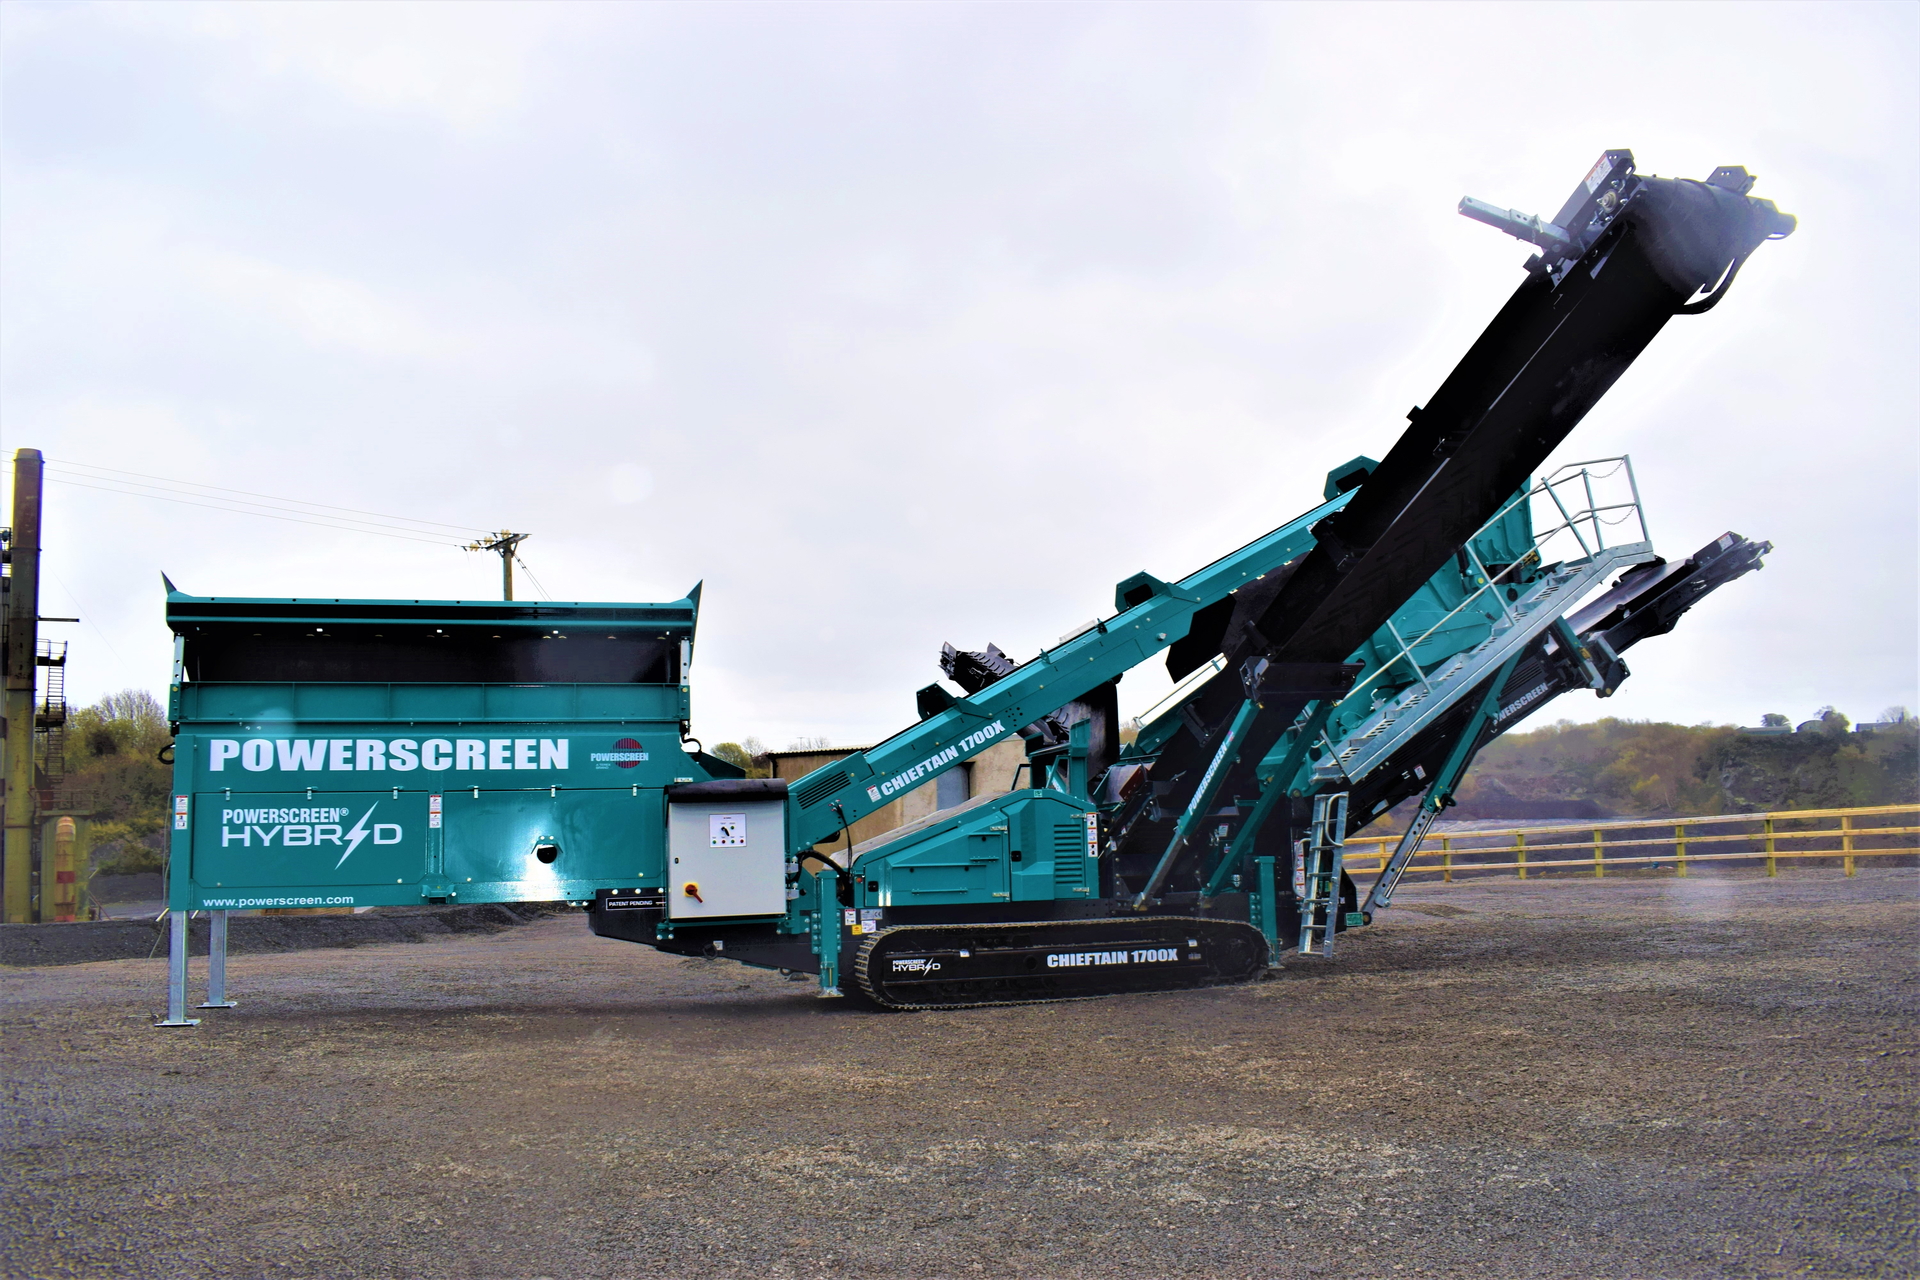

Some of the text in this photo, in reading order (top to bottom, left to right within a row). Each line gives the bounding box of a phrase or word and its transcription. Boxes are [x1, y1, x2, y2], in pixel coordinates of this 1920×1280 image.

[209, 738, 569, 771] POWERSCREEN
[590, 752, 649, 761] POWERSCREEN
[880, 746, 959, 796] CHIEFTAIN
[958, 719, 1006, 752] 1700X
[1188, 741, 1227, 816] POWERSCREEN
[203, 896, 354, 908] www.powerscreen.com
[1047, 951, 1128, 968] CHIEFTAIN
[1131, 948, 1178, 963] 1700X
